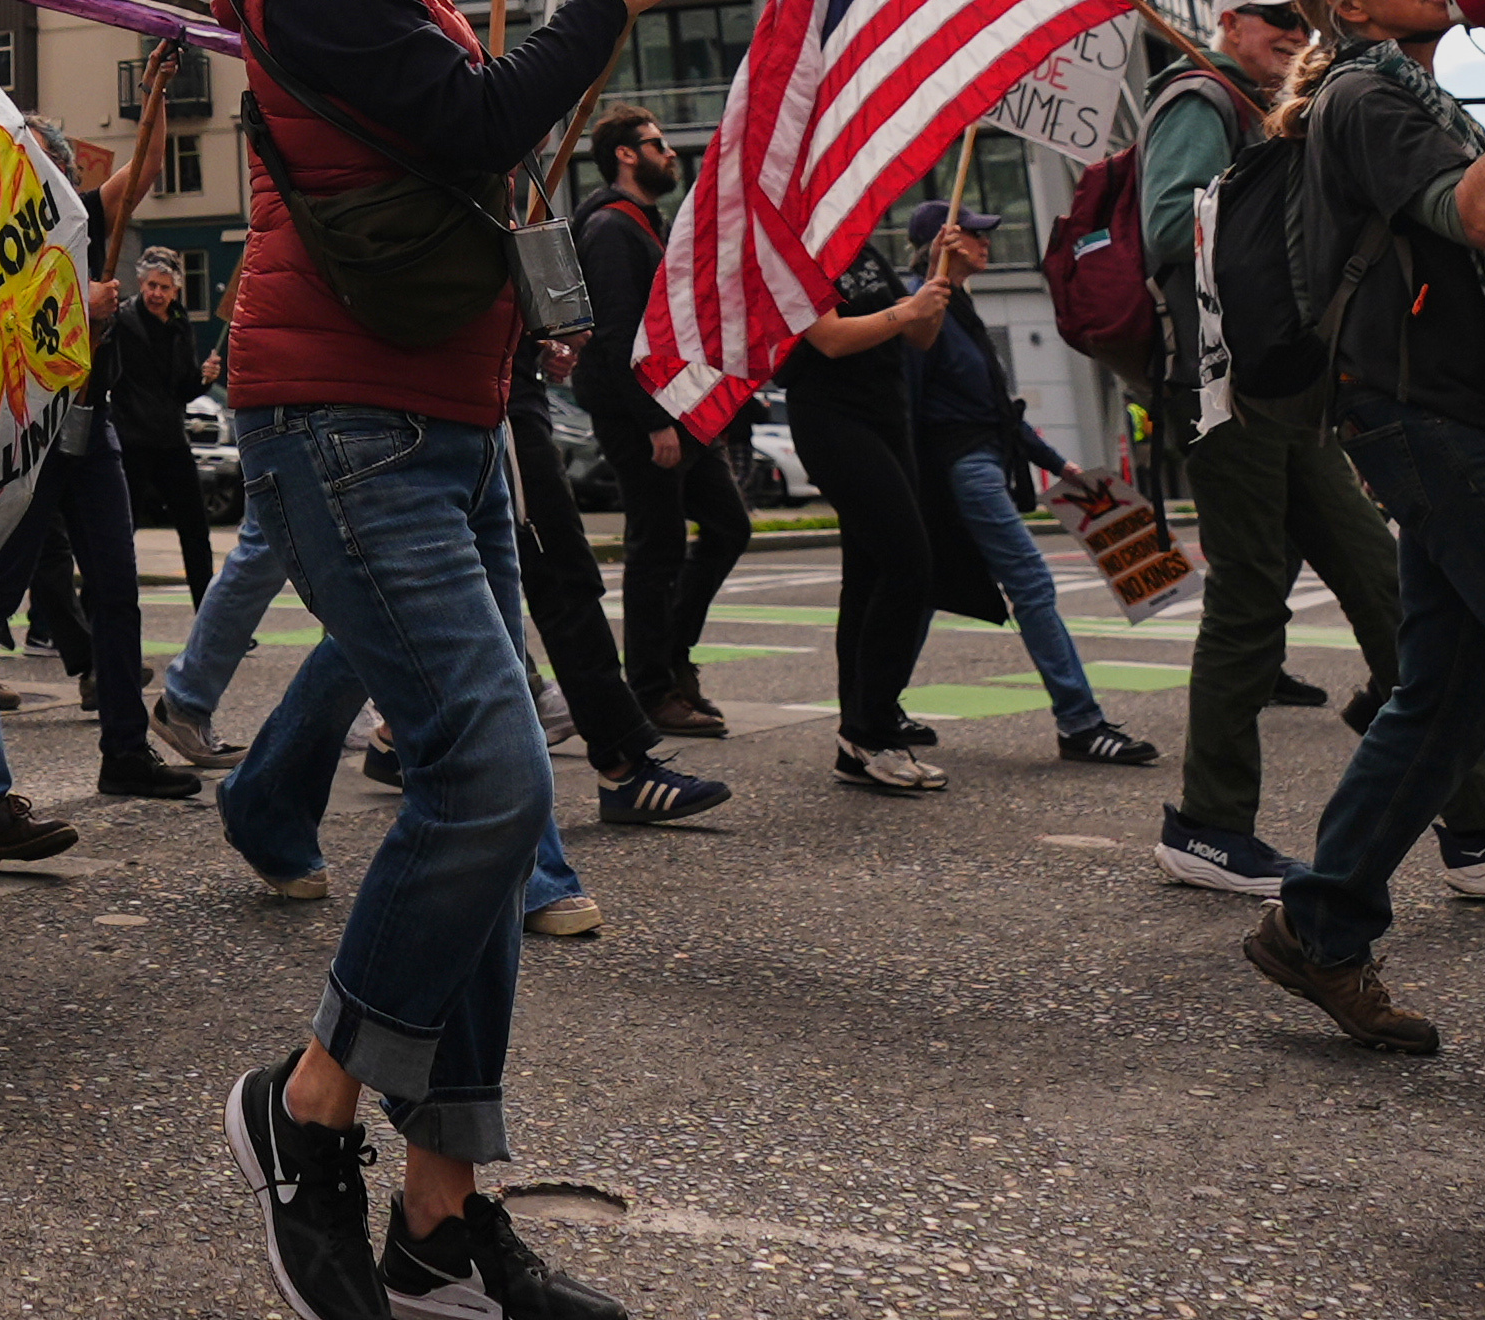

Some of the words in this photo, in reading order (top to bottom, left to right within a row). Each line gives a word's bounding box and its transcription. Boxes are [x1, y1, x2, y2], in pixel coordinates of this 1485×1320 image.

[31, 296, 60, 355] &
[1116, 575, 1146, 605] NO
[1139, 552, 1190, 592] KINGS
[1186, 838, 1228, 866] HOKA
